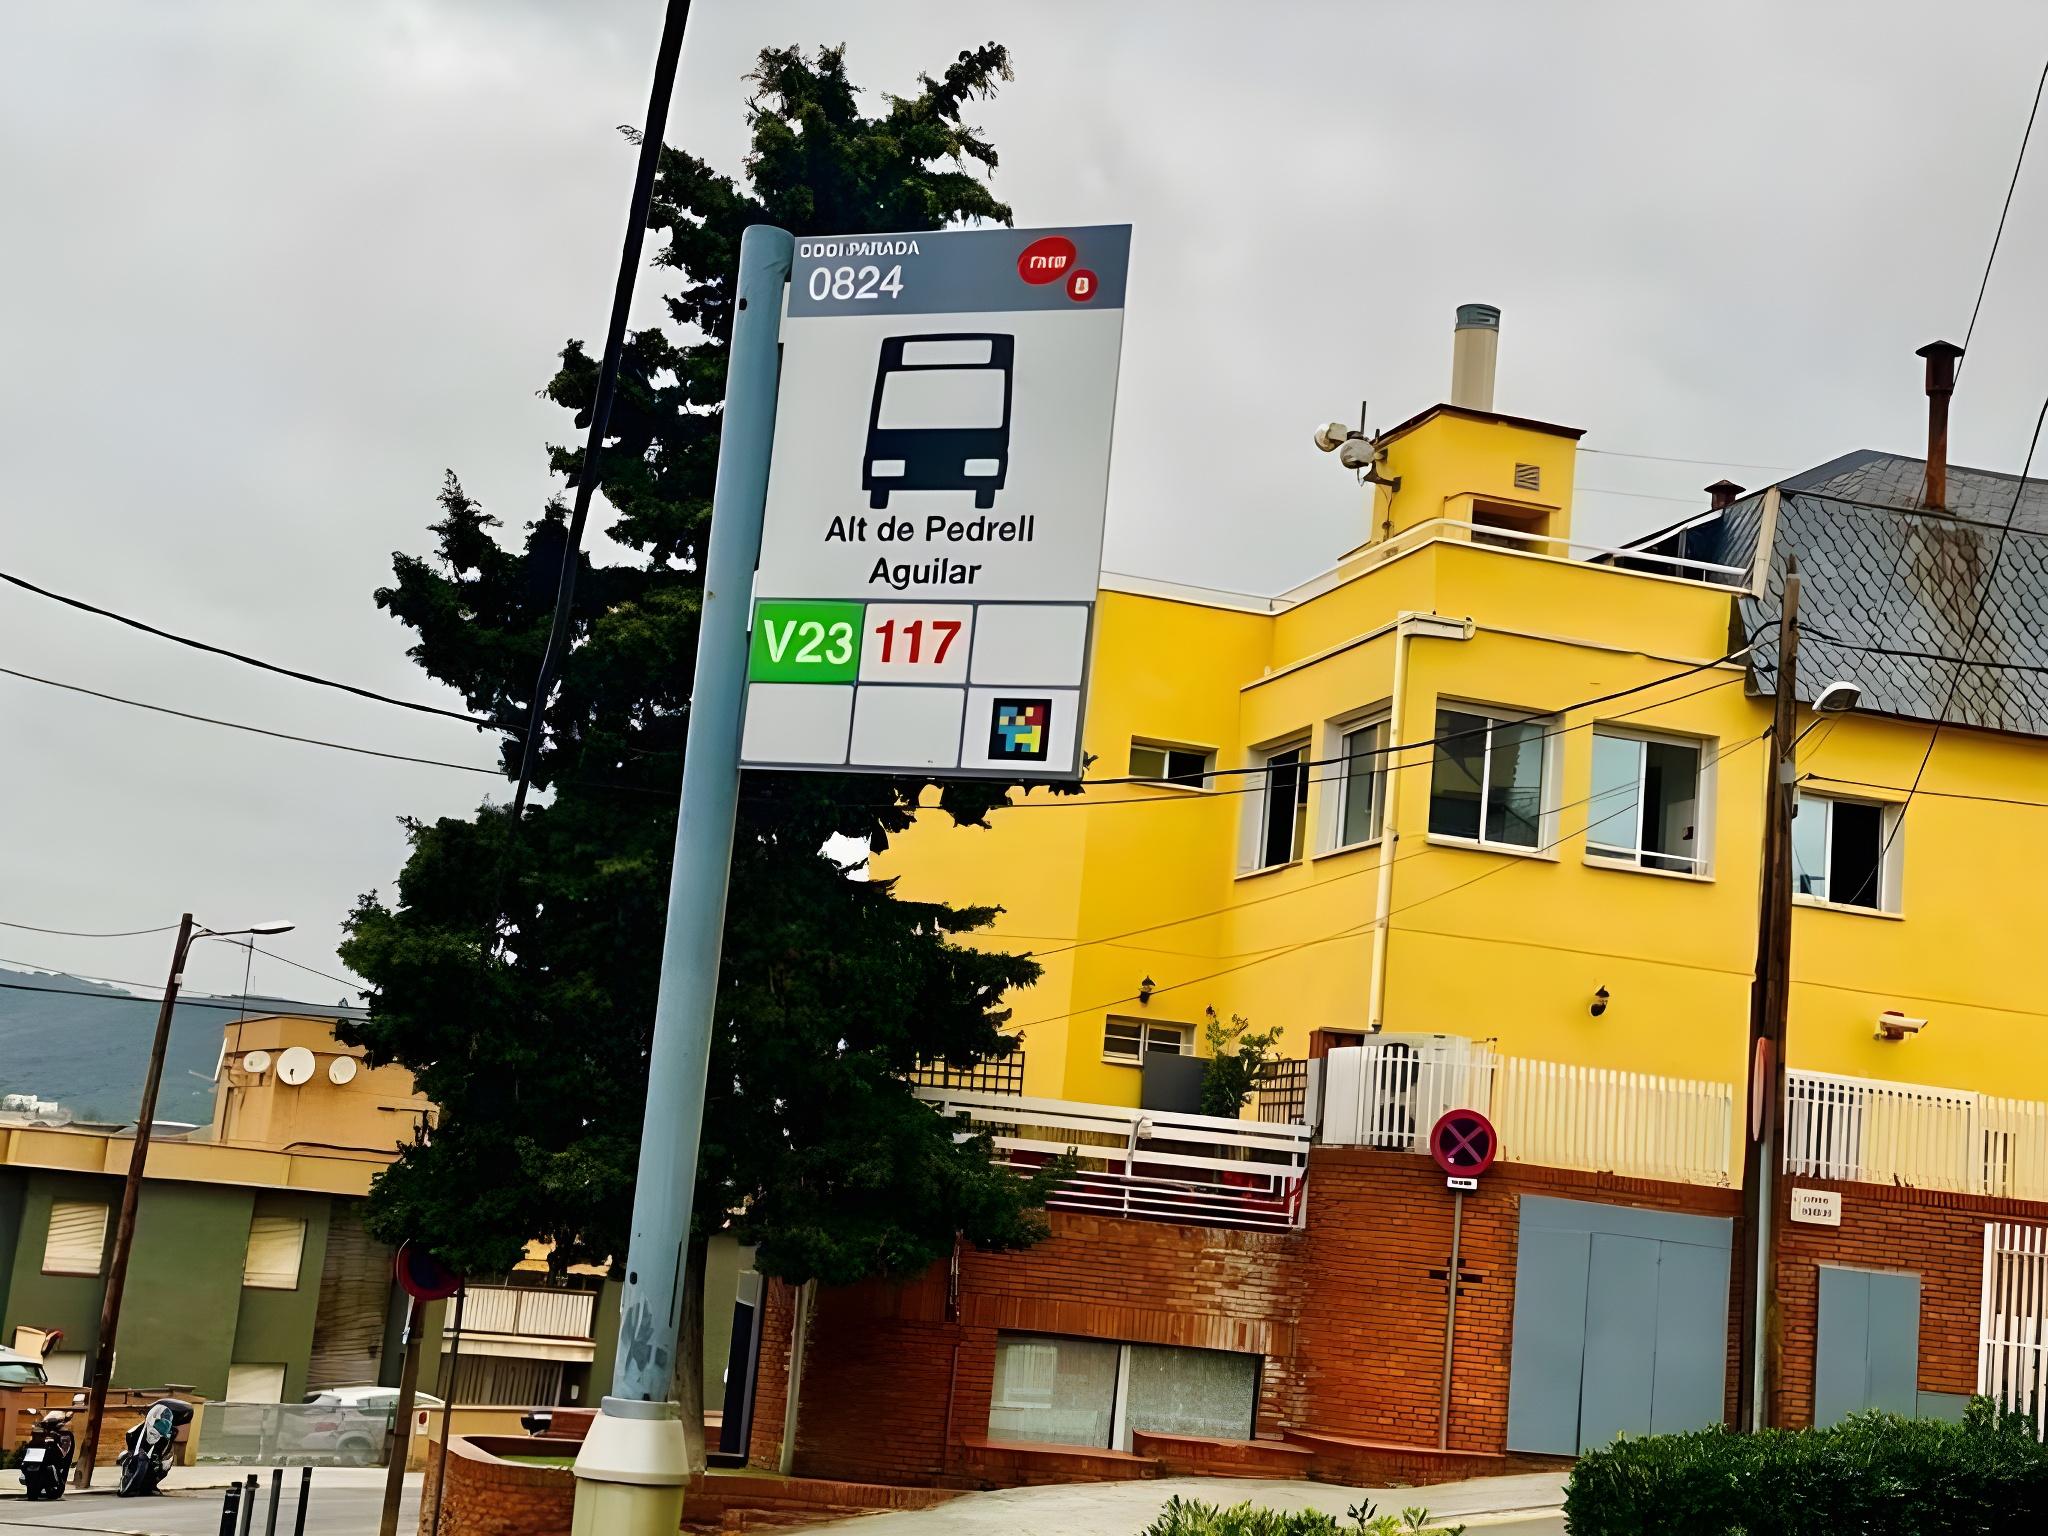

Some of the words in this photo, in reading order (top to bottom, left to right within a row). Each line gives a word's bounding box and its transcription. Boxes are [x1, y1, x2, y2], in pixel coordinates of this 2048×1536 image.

[809, 265, 904, 301] 0824
[825, 515, 866, 542] Alt
[877, 515, 914, 542] de
[925, 515, 1034, 542] Pedrell
[868, 557, 981, 590] Aguilar
[763, 619, 853, 664] V23
[875, 619, 962, 663] 117
